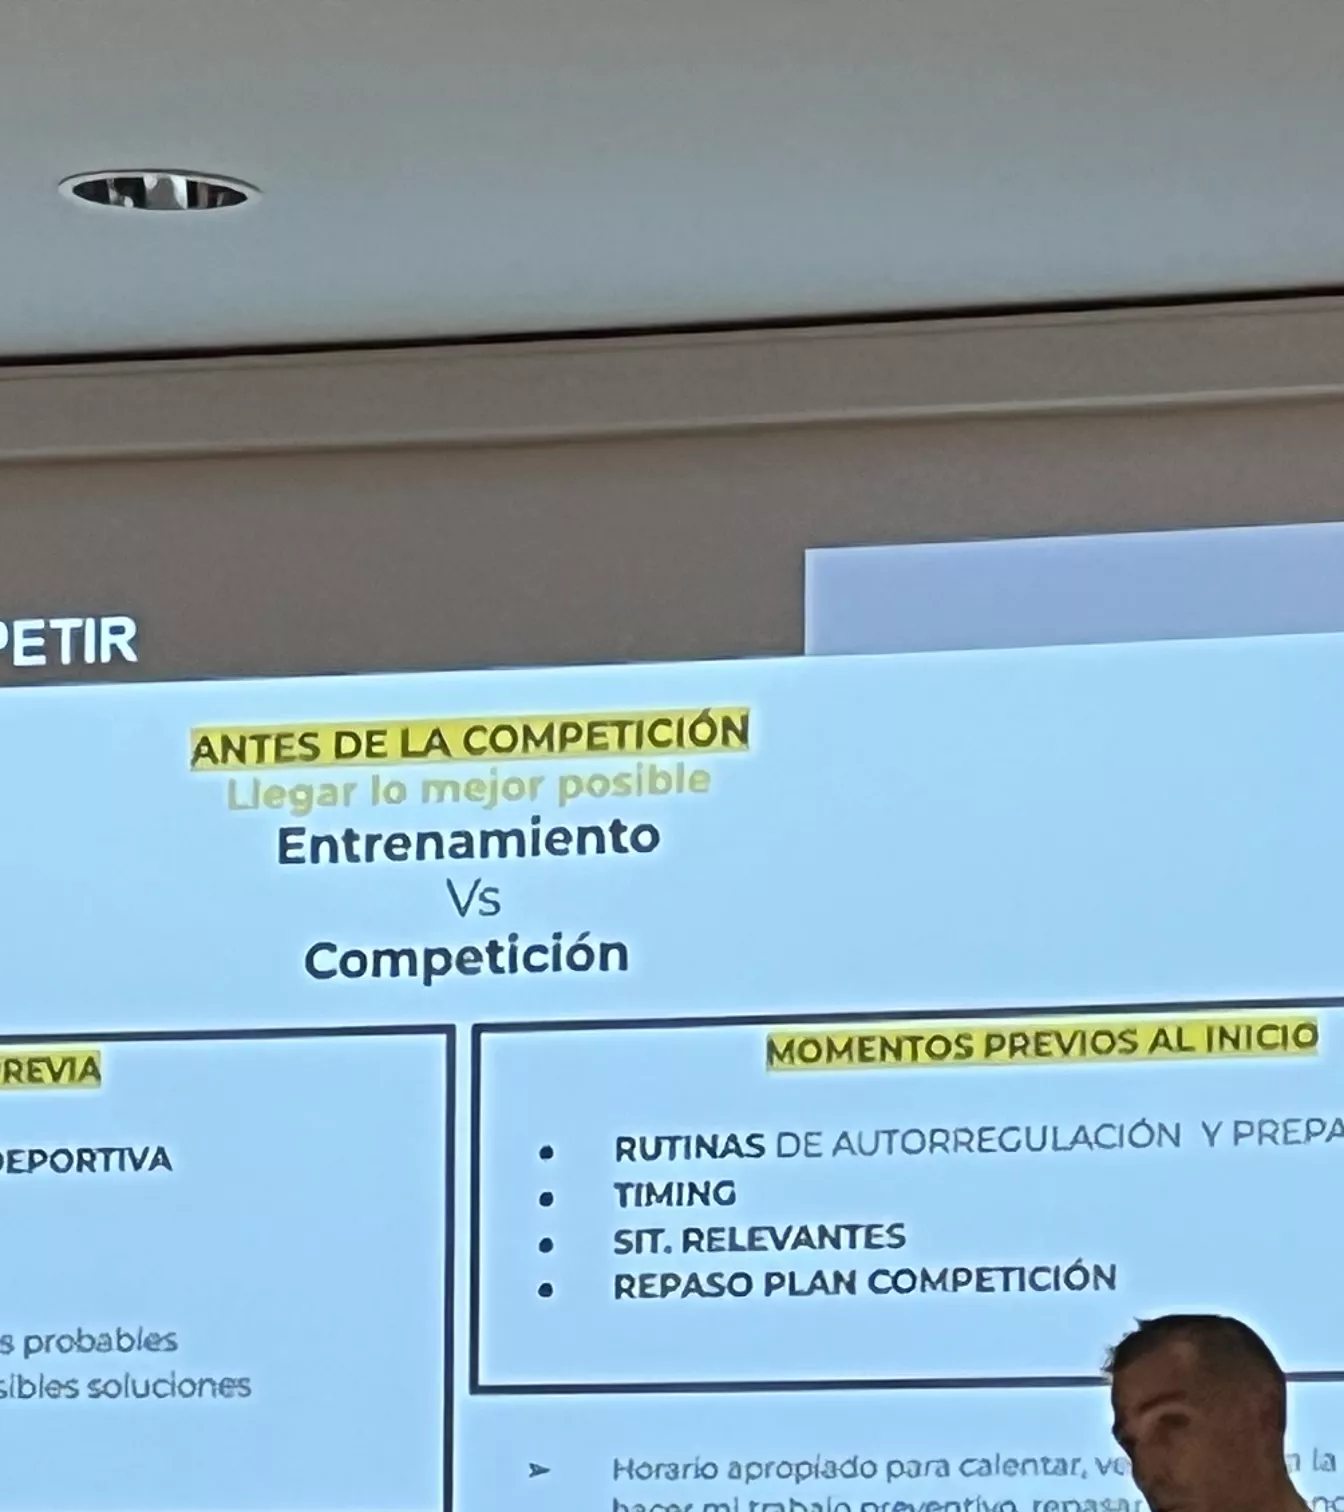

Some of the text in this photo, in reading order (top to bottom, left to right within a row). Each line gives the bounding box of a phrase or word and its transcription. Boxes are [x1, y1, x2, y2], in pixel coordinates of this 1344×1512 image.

[191, 710, 749, 765] ANTES DE LA COMPETICIÓN
[227, 762, 710, 813] Llegar lo mejor posible
[277, 813, 661, 866] Entrenamiento
[445, 876, 503, 919] Vs
[304, 930, 629, 988] Competición
[766, 1023, 1319, 1065] MOMENTOS PREVIOS AL INICIO
[614, 1131, 767, 1164] RUTINAS
[775, 1130, 824, 1160] DE
[831, 1116, 1181, 1158] AUTORREGULACIÓN
[1200, 1120, 1224, 1149] Y
[612, 1178, 738, 1209] TIMING
[613, 1221, 908, 1256] SIT. RELEVANTES
[613, 1257, 1117, 1301] REPASO PLAN COMPETICIÓN
[22, 1325, 180, 1362] probables
[86, 1369, 253, 1401] soluciones
[611, 1455, 721, 1483] Horario
[726, 1453, 879, 1486] apropiado
[885, 1457, 951, 1486] para
[957, 1451, 1088, 1481] calentar,
